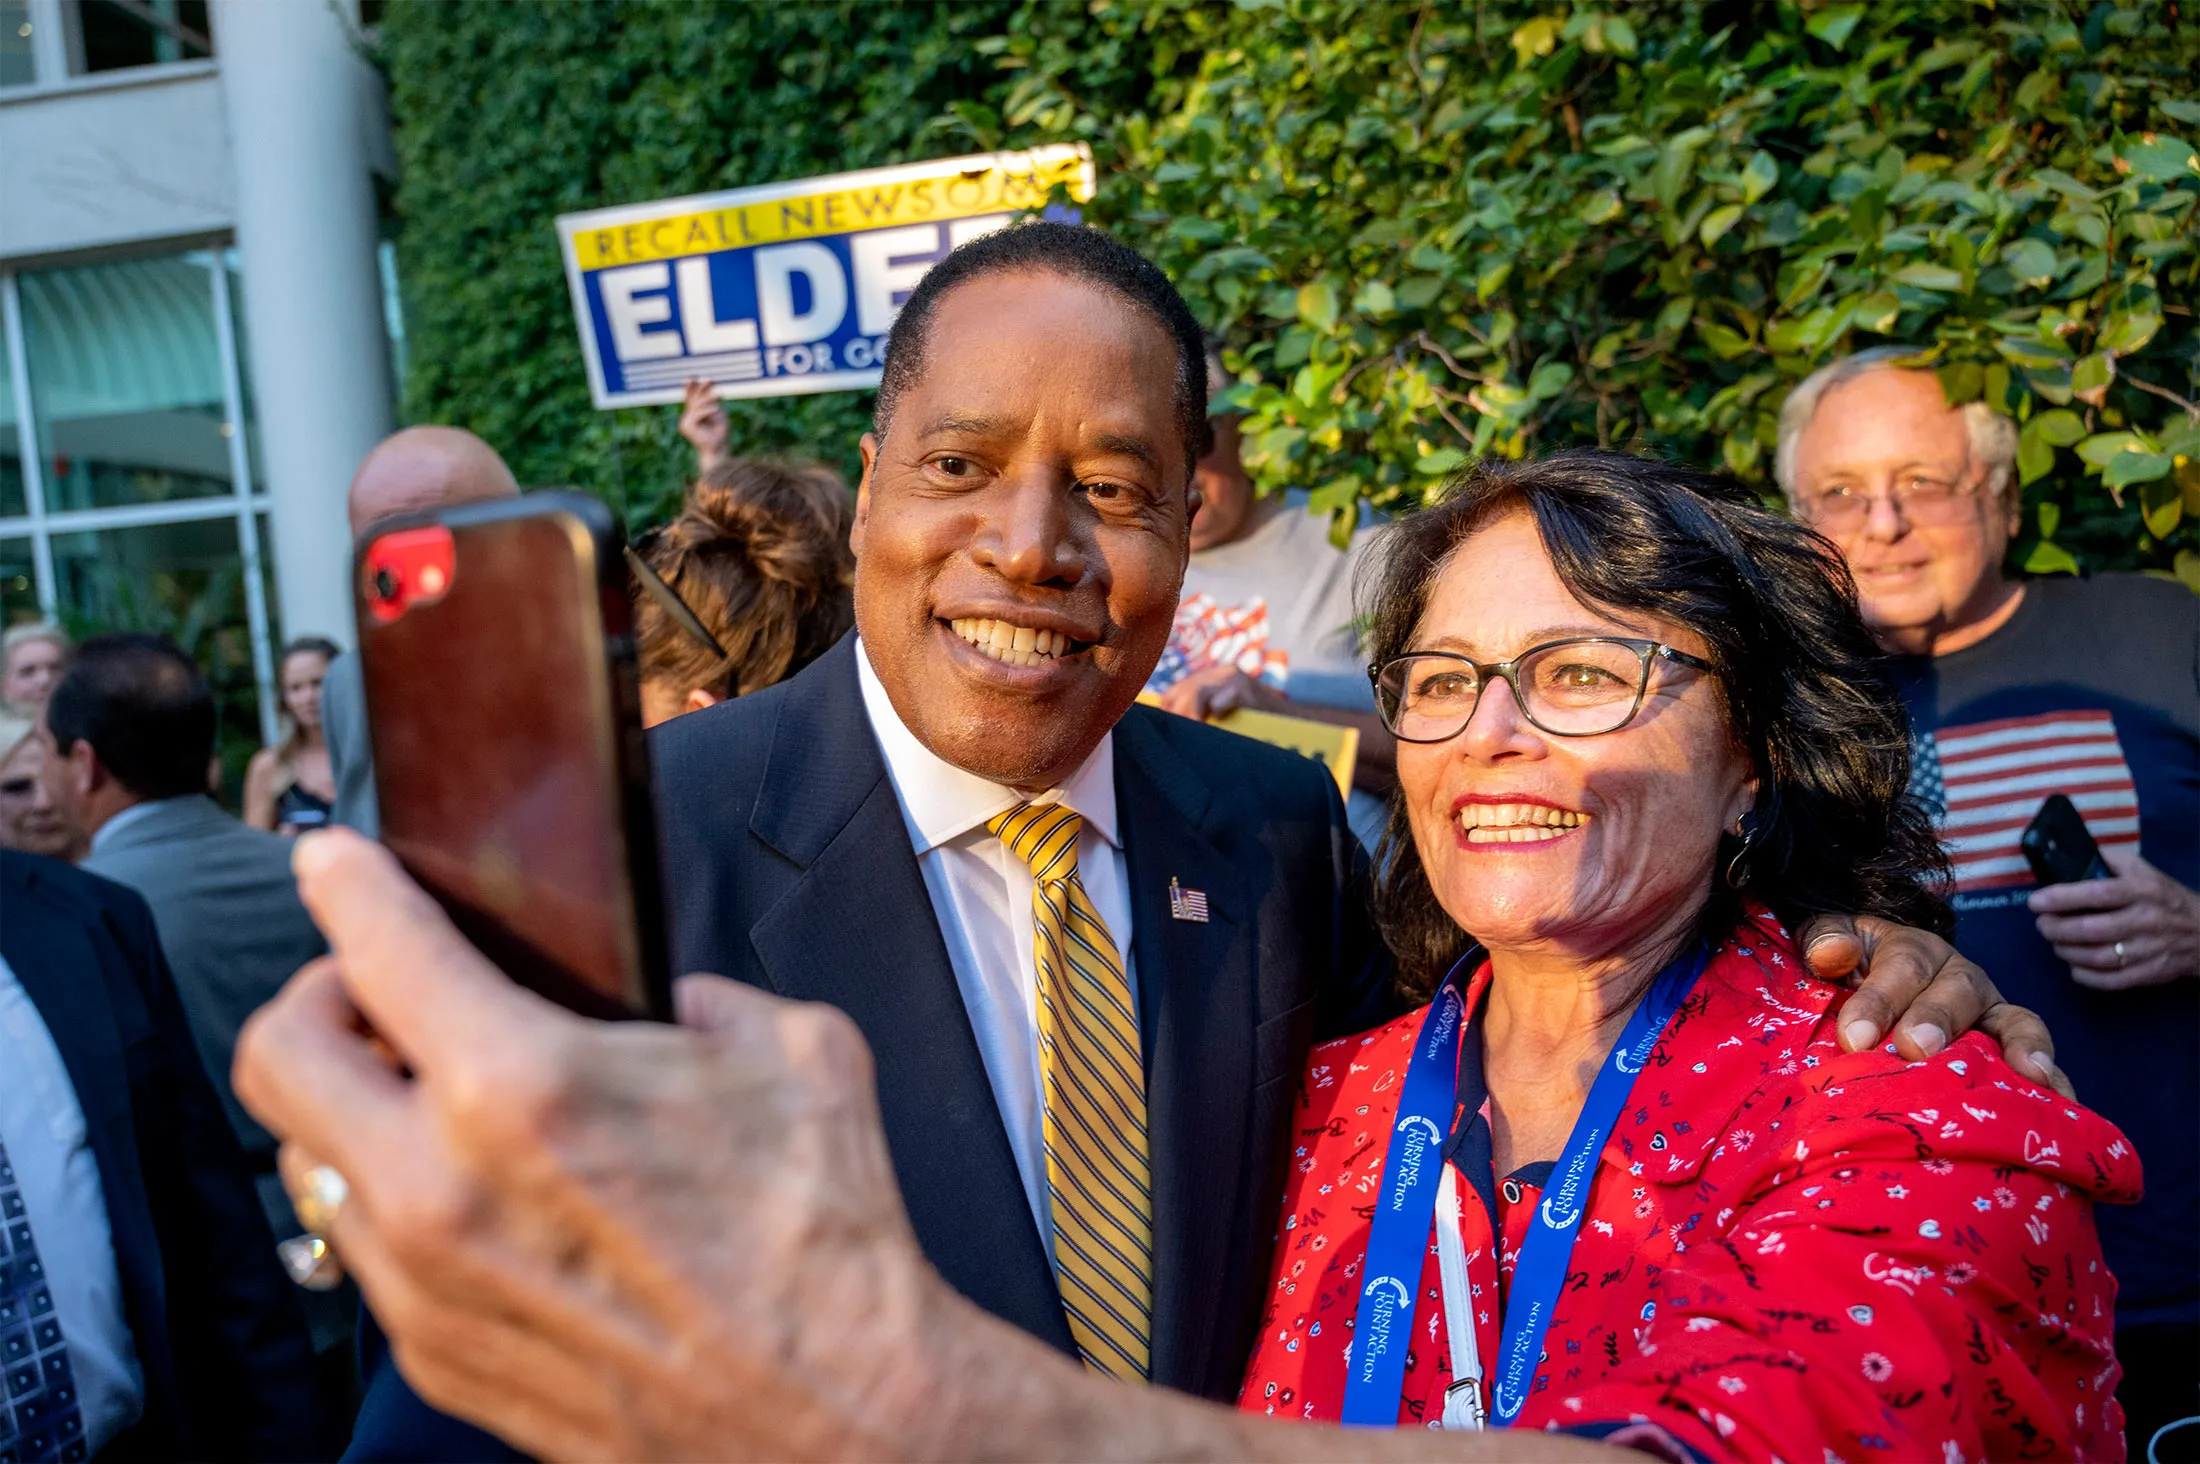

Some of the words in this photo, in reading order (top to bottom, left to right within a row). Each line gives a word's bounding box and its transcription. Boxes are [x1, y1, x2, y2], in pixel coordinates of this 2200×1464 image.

[596, 211, 758, 263] RECALL
[782, 170, 1044, 232] NEWSOM
[600, 213, 1014, 361] ELDE
[764, 340, 837, 377] FOR
[1427, 1022, 1443, 1060] ACTION
[1628, 1016, 1668, 1061] TURNING
[1402, 1128, 1418, 1165] POINT
[1407, 1131, 1428, 1186] TURNING
[1561, 1173, 1580, 1214] POINT
[1577, 1128, 1599, 1172] ACTION
[1393, 1165, 1409, 1211] ACTION
[1553, 1154, 1581, 1213] TURNING
[1371, 1291, 1386, 1333] POINT
[1376, 1292, 1396, 1355] TURNING
[1363, 1333, 1378, 1383] ACTION
[1504, 1331, 1525, 1399] TURNING
[1508, 1357, 1526, 1401] POINT
[1521, 1301, 1541, 1354] ACTION
